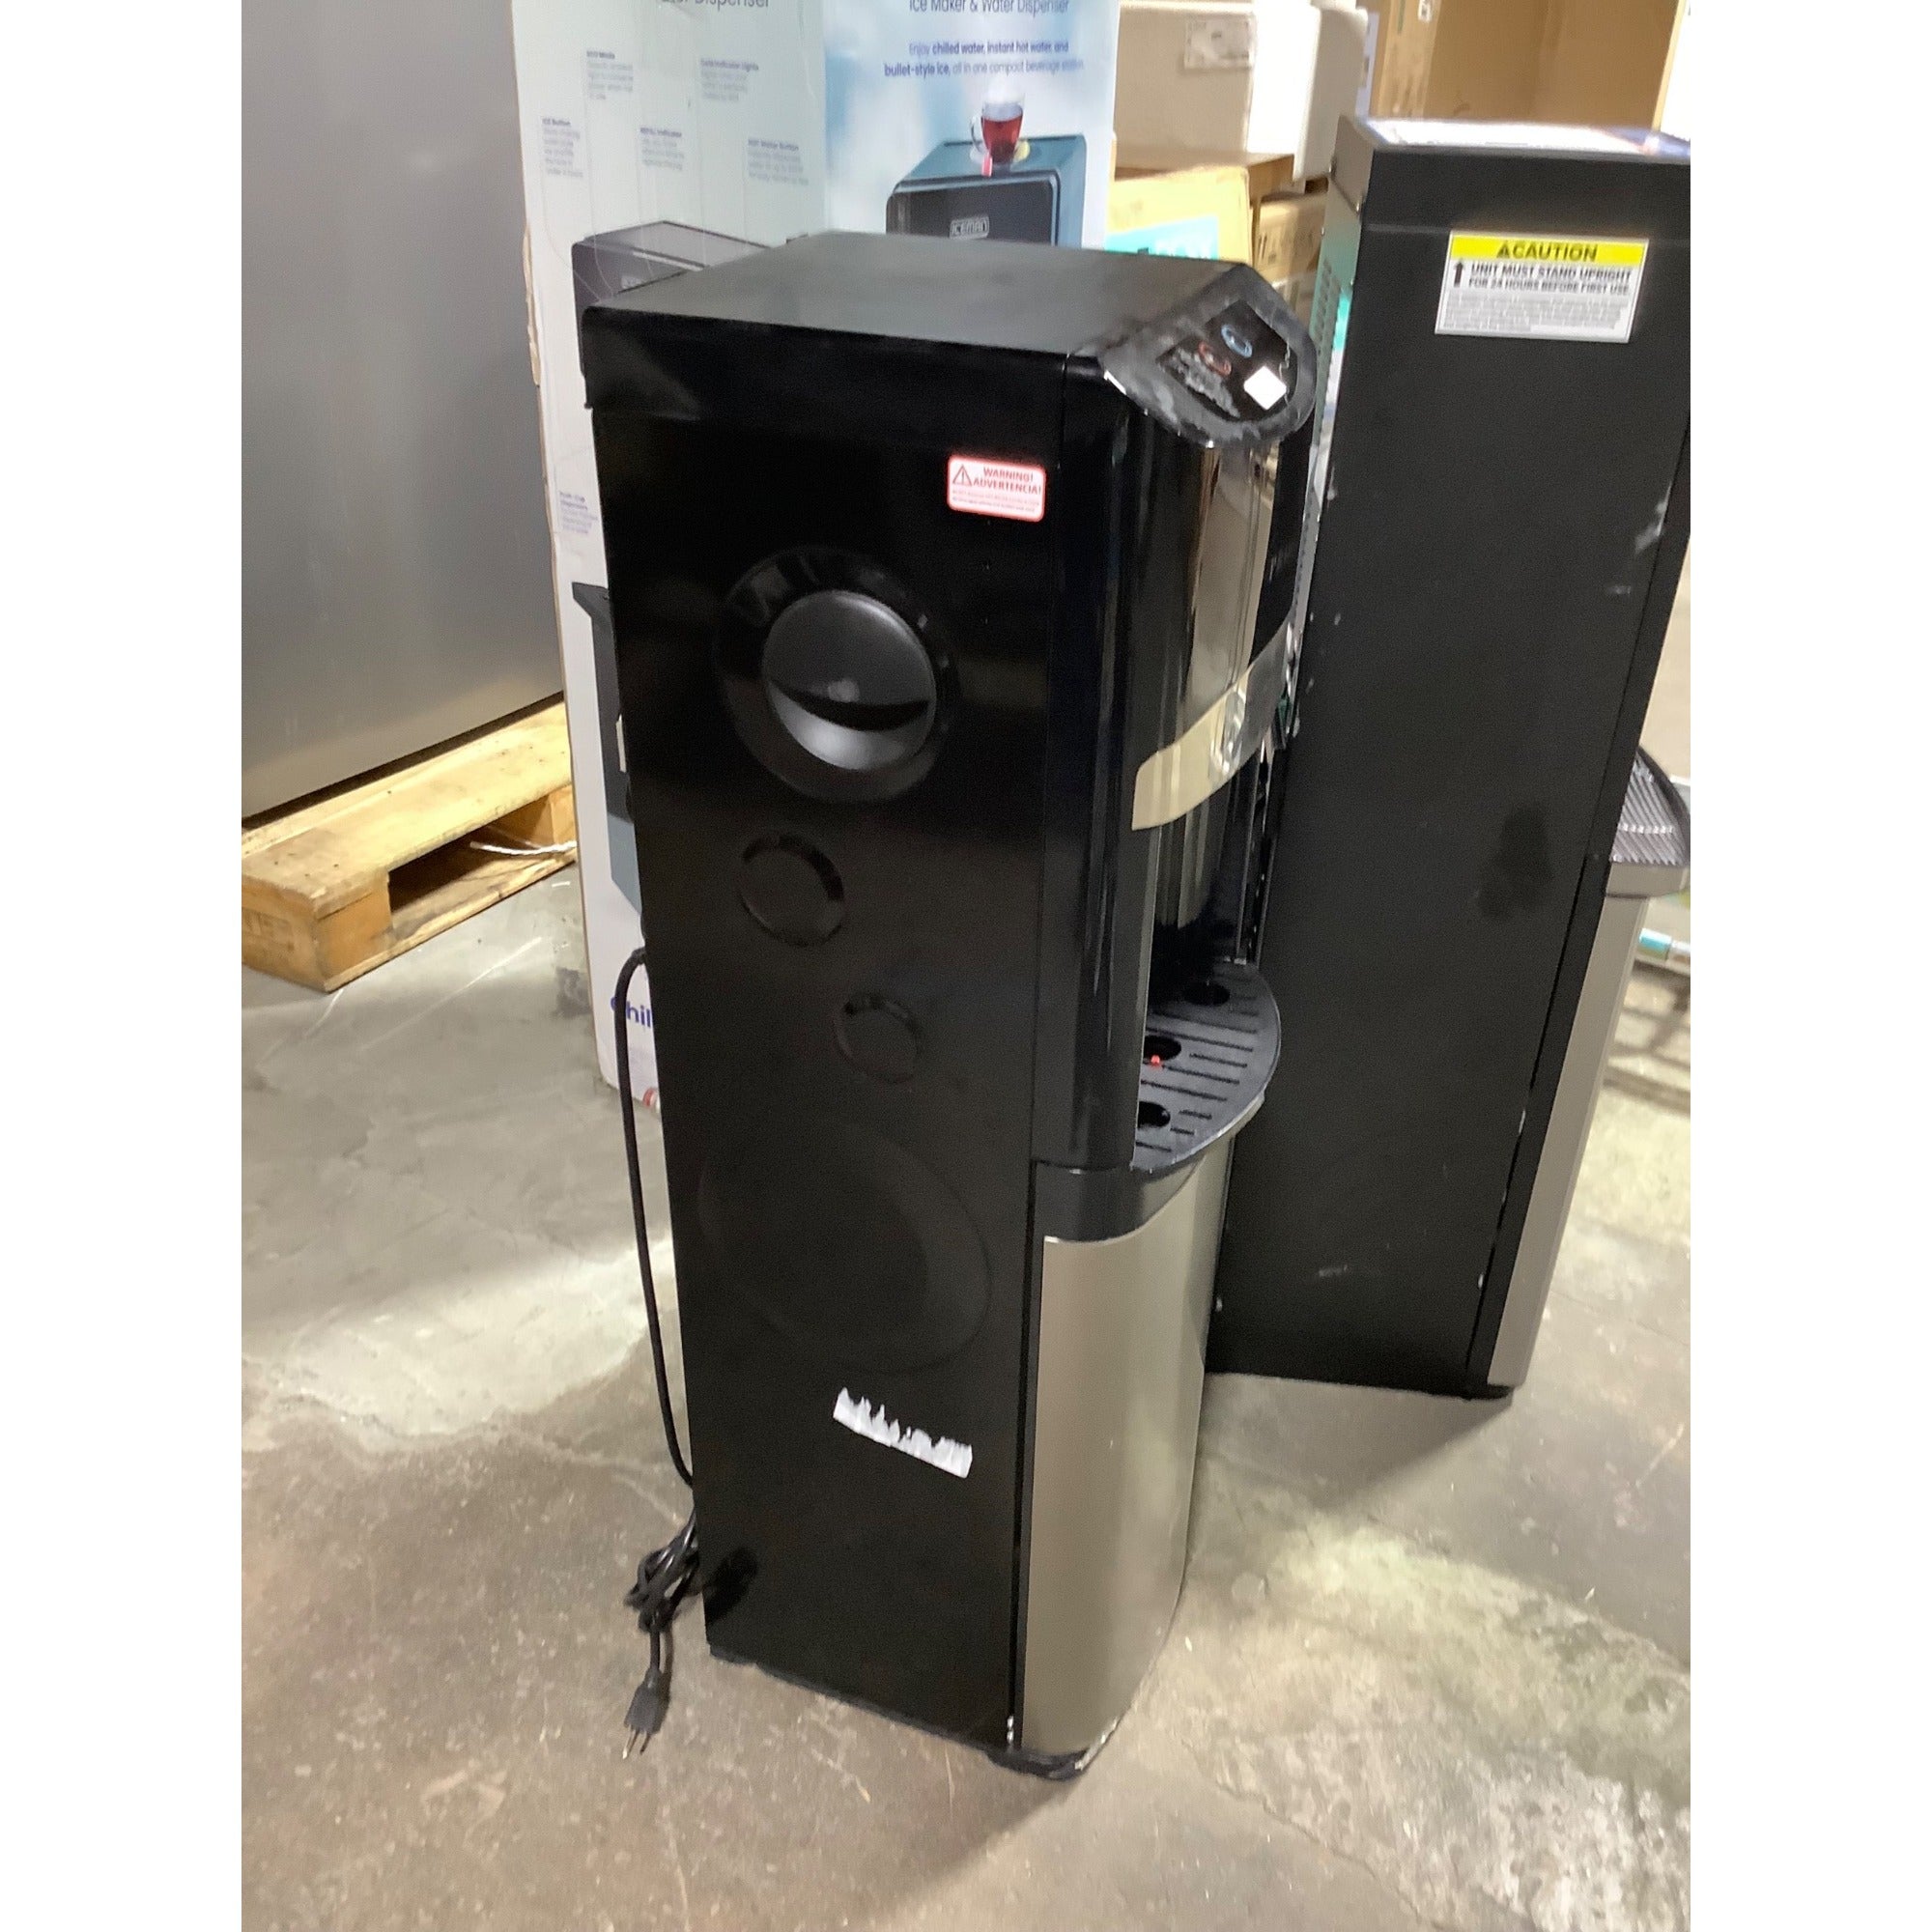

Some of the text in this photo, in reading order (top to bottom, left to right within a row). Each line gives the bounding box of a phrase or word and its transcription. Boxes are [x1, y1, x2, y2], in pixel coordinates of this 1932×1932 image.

[695, 0, 770, 12] spenser
[910, 0, 1069, 19] Ice Maker & Water Dispenser
[932, 42, 959, 55] chilled
[960, 43, 985, 55] water,
[986, 42, 1014, 54] instant
[1015, 42, 1029, 53] hot
[1054, 42, 1068, 53] and
[884, 62, 935, 79] bullet-style
[937, 62, 951, 76] ice,
[973, 63, 988, 74] one
[989, 61, 1024, 76] compact
[1513, 242, 1599, 263] CAUTION
[1471, 263, 1632, 284] UNIT MUST STAND UPRIGHT
[1468, 277, 1630, 297] FOR 24 HOURS BEFORE FIRST USE
[983, 467, 1034, 484] WARNING!
[973, 476, 1041, 496] ADVERTENCIA!
